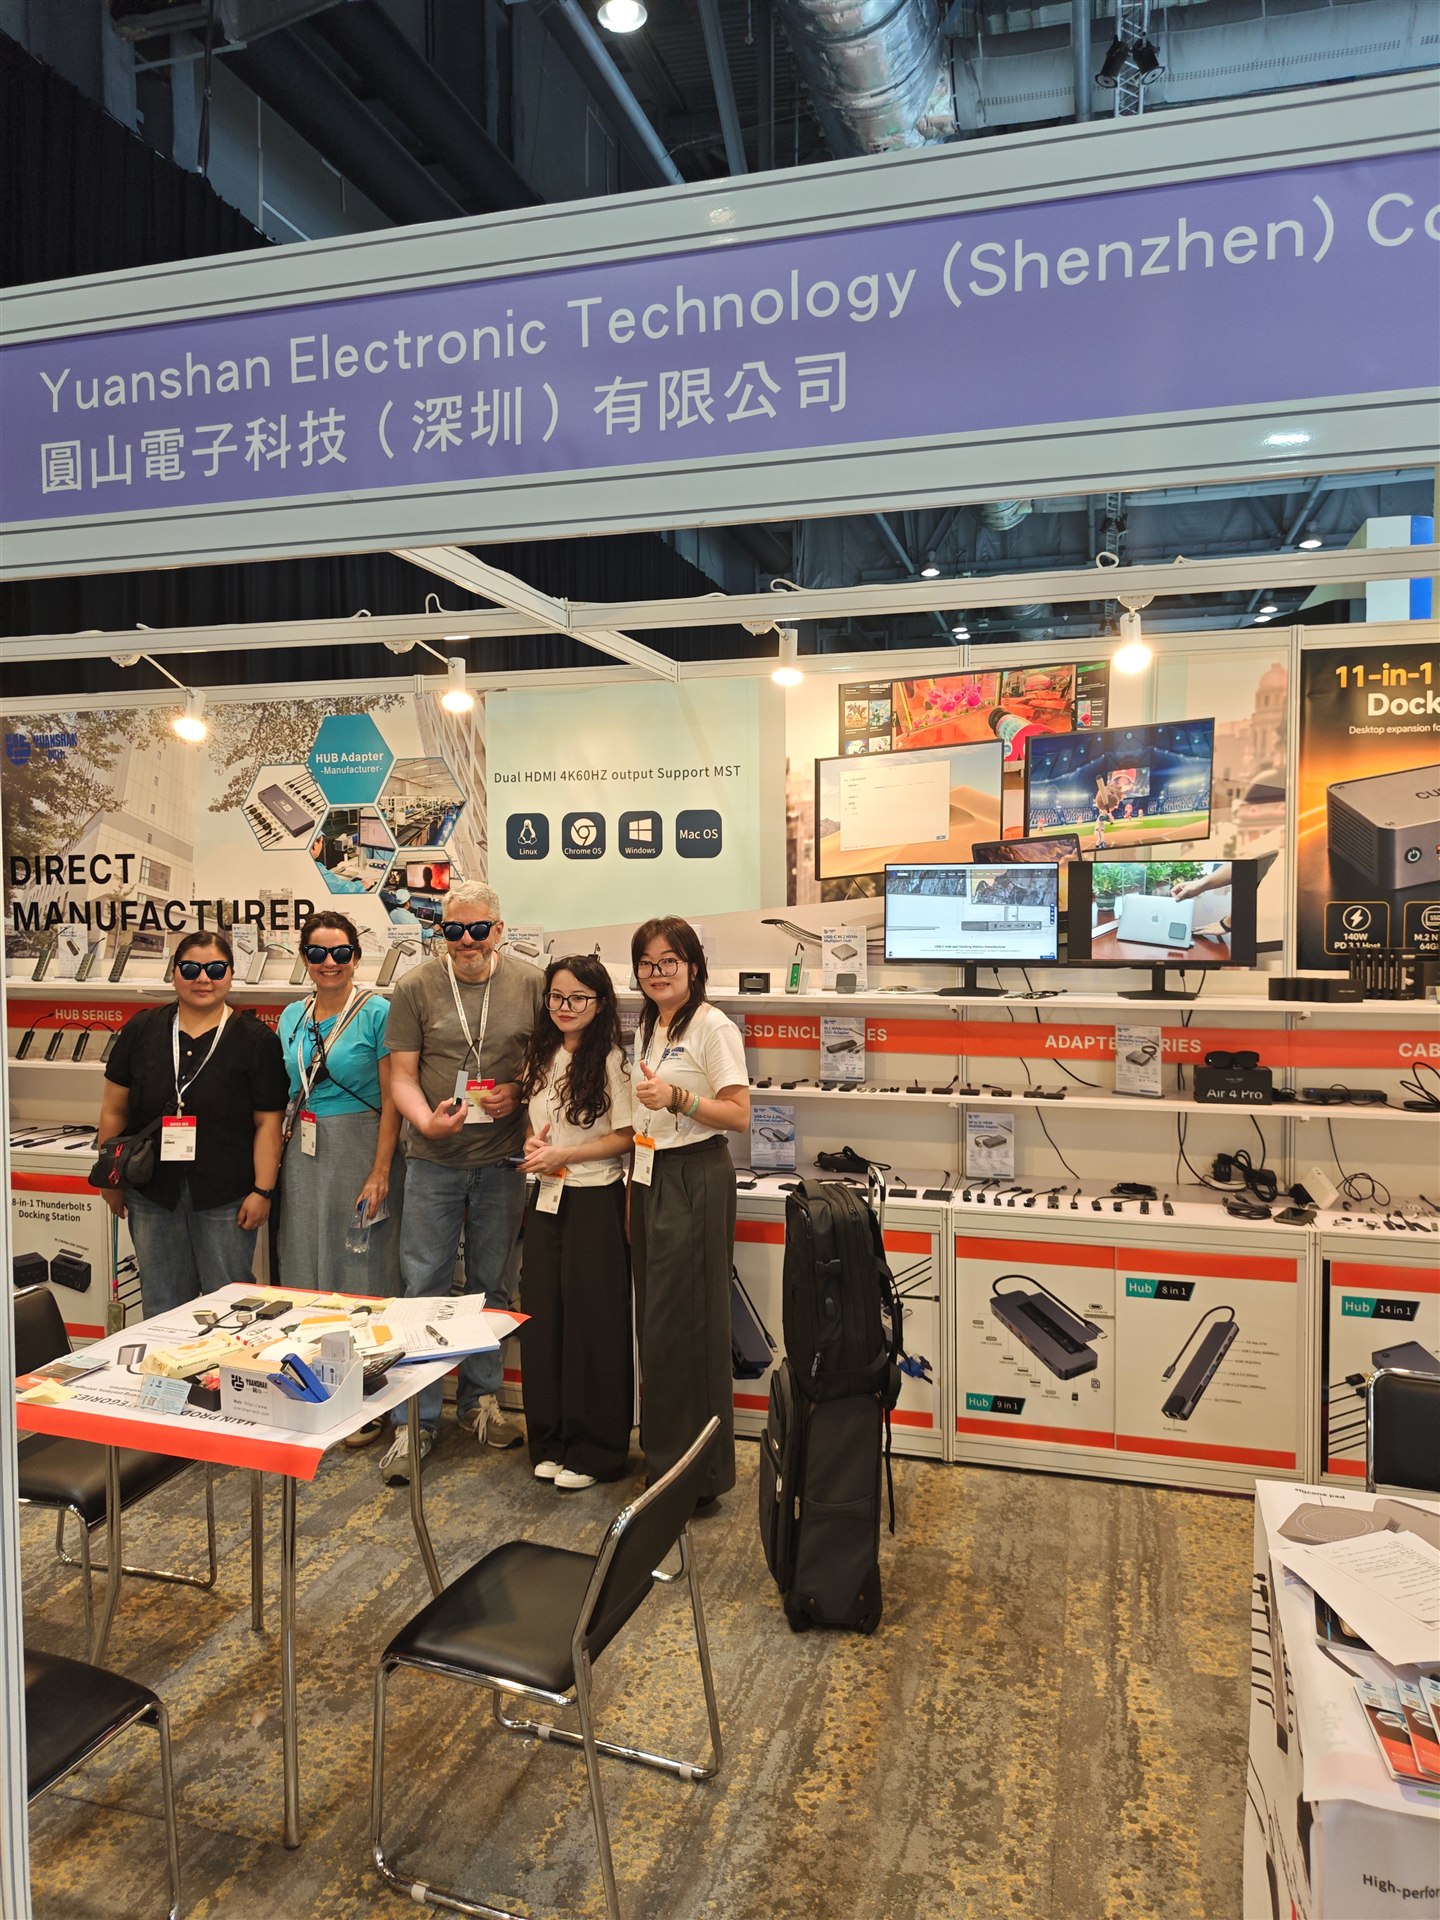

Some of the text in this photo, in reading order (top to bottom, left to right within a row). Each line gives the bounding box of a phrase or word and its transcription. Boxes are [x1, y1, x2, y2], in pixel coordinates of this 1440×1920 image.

[40, 352, 271, 413] Yuanshan
[291, 310, 547, 384] Electronic
[568, 268, 917, 349] Technology
[943, 194, 1334, 308] (Shenzhen)
[1335, 662, 1432, 688] 11-in-1
[1367, 690, 1440, 717] Dock
[1348, 725, 1385, 736] Desktop
[1386, 723, 1431, 735] expansion
[315, 752, 384, 764] HUB Adapter
[320, 765, 383, 775] -Manufacturer-
[494, 765, 741, 783] Dual HDMI 4K60HZ output Support MST
[679, 828, 719, 840] Mac OS
[519, 847, 538, 855] Linux
[564, 847, 602, 855] Chrome OS
[625, 846, 656, 855] Windows
[10, 854, 136, 886] DIRECT
[13, 899, 315, 932] MANUFACTURER
[1343, 932, 1368, 941] 140W
[1413, 933, 1430, 941] M.2
[55, 1009, 123, 1021] HUB SERIES
[744, 1024, 774, 1038] SSD
[1206, 1089, 1263, 1099] Air 4 Pro
[12, 1198, 92, 1211] 8-in-1 Thunderbolt 5
[18, 1210, 81, 1222] Docking Station
[1129, 1283, 1187, 1296] Hub 8 in 1
[1345, 1301, 1411, 1315] Hub 14 in 1
[246, 1379, 268, 1389] YUANSHAN
[969, 1396, 989, 1407] Hub
[1003, 1401, 1012, 1409] in
[1014, 1402, 1018, 1410] 1
